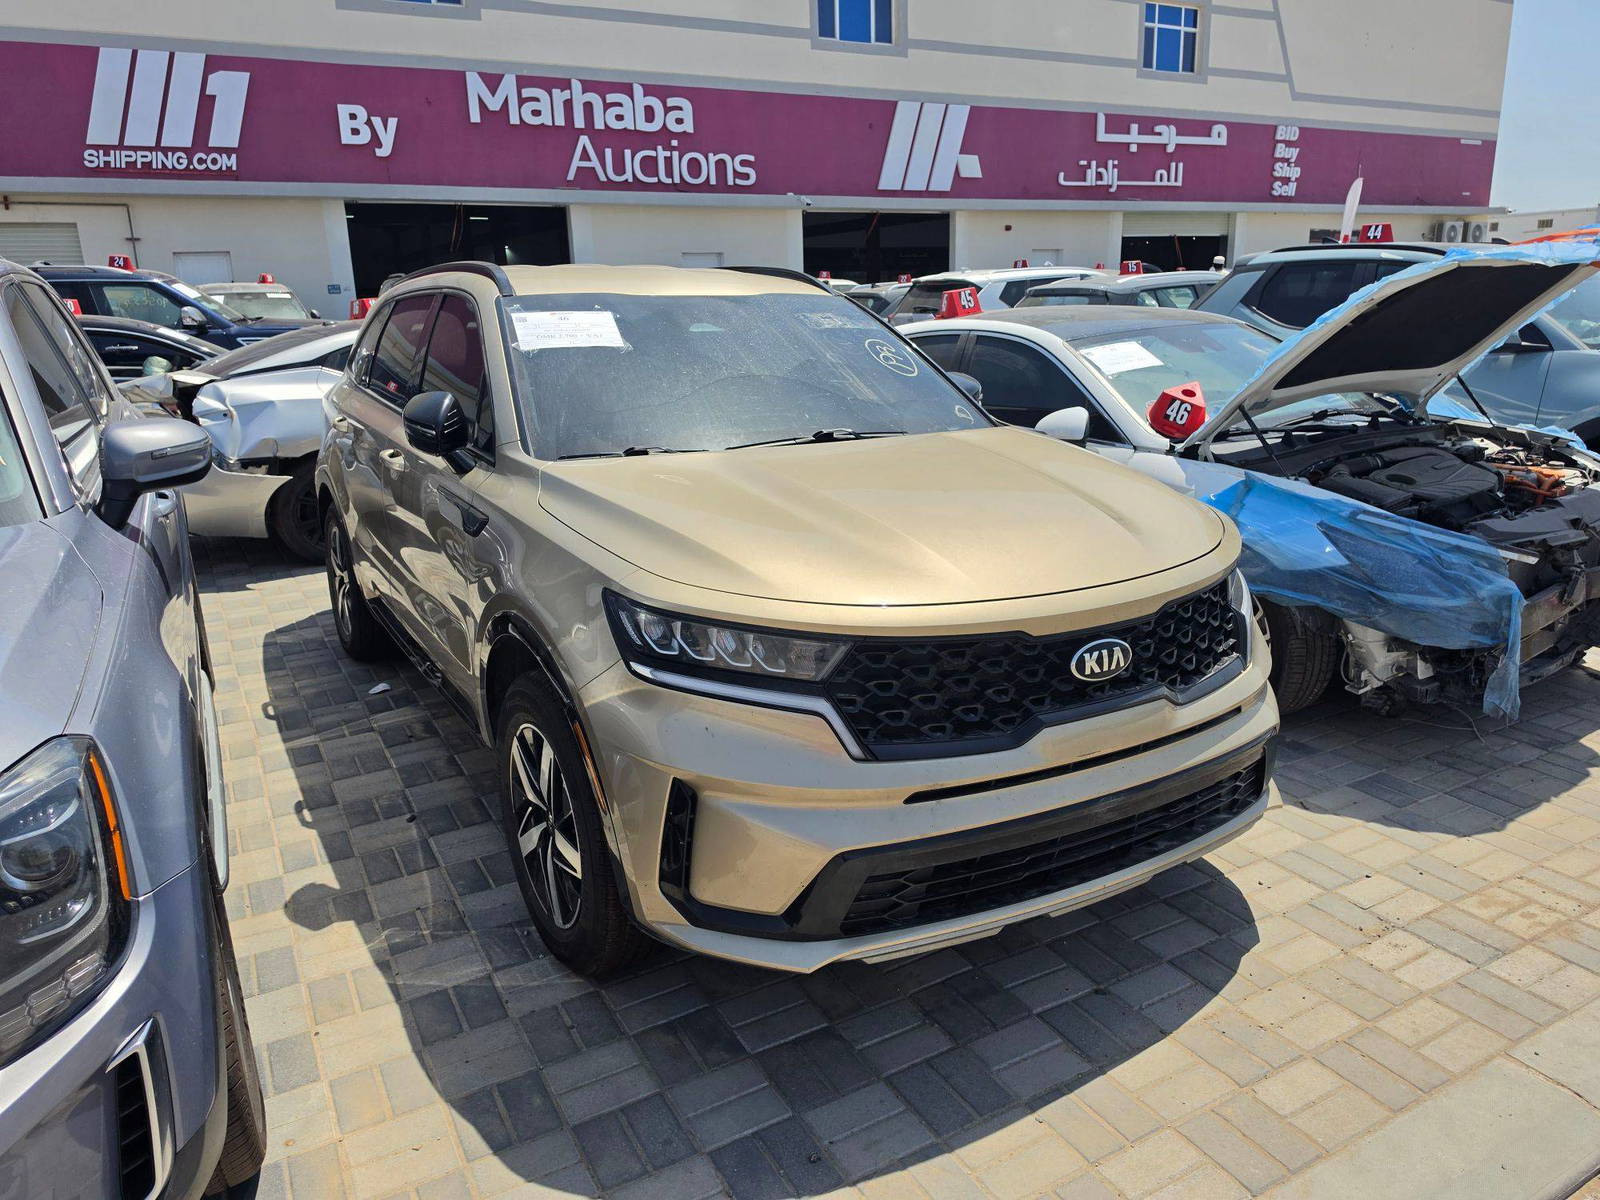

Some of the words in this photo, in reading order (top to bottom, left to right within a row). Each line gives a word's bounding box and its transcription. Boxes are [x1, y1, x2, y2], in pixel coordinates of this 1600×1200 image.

[465, 71, 694, 133] Marhaba
[336, 103, 398, 157] By
[1096, 112, 1228, 153] مرحبا
[1274, 125, 1299, 141] BID
[83, 149, 237, 171] SHIPPING.COM
[566, 135, 757, 186] Auctions
[1273, 143, 1299, 162] Buy
[1058, 159, 1183, 193] للمزادات
[1272, 162, 1300, 181] Ship
[1271, 181, 1297, 197] Sell
[1367, 224, 1384, 240] 44
[114, 256, 124, 267] 24
[1128, 261, 1137, 272] 15
[960, 289, 975, 309] 45
[1165, 400, 1192, 425] 46
[1084, 647, 1124, 674] KIA
